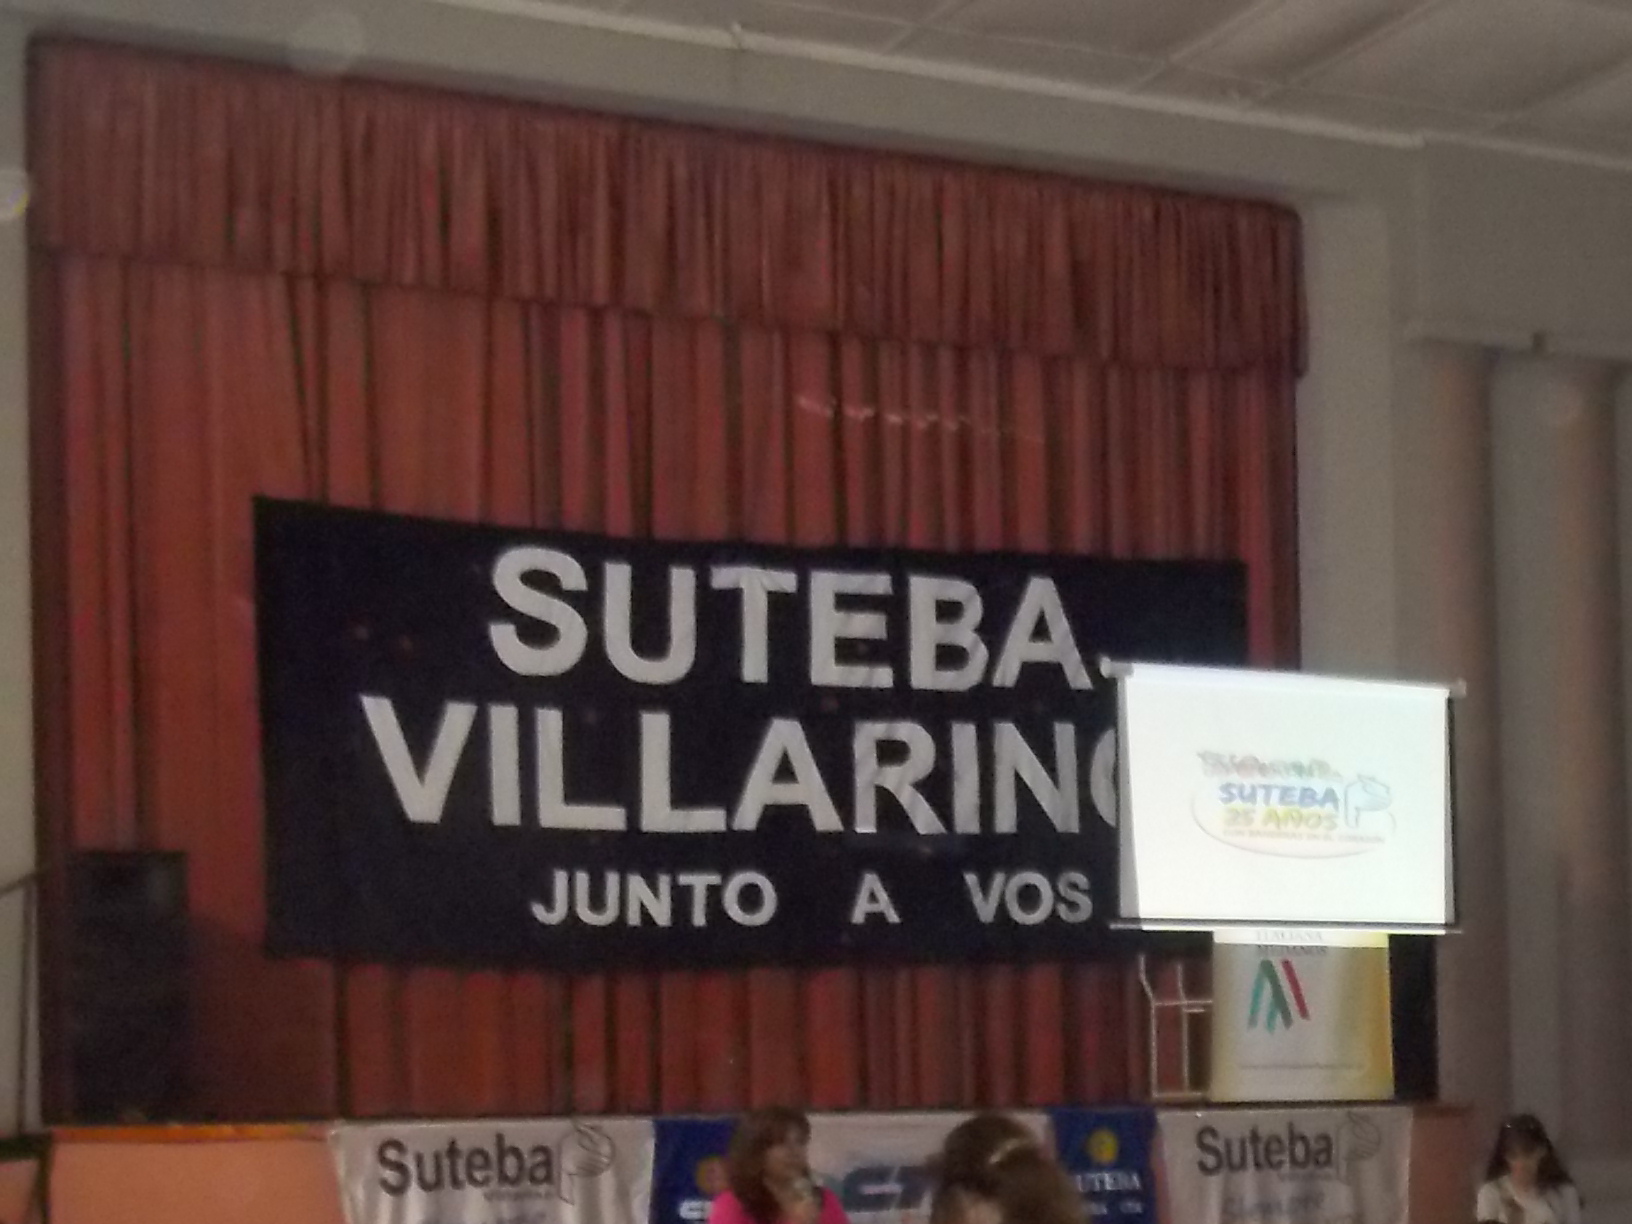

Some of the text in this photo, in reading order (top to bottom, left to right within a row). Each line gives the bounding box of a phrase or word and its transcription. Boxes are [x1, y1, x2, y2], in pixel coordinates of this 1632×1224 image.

[488, 545, 1094, 692] SUTEBA
[360, 695, 1116, 834] VILLARIN
[1218, 782, 1339, 811] SUTEBA
[531, 870, 1093, 927] JUNTO A VOS
[377, 1132, 555, 1196] Suteba
[1196, 1121, 1334, 1176] Suteba
